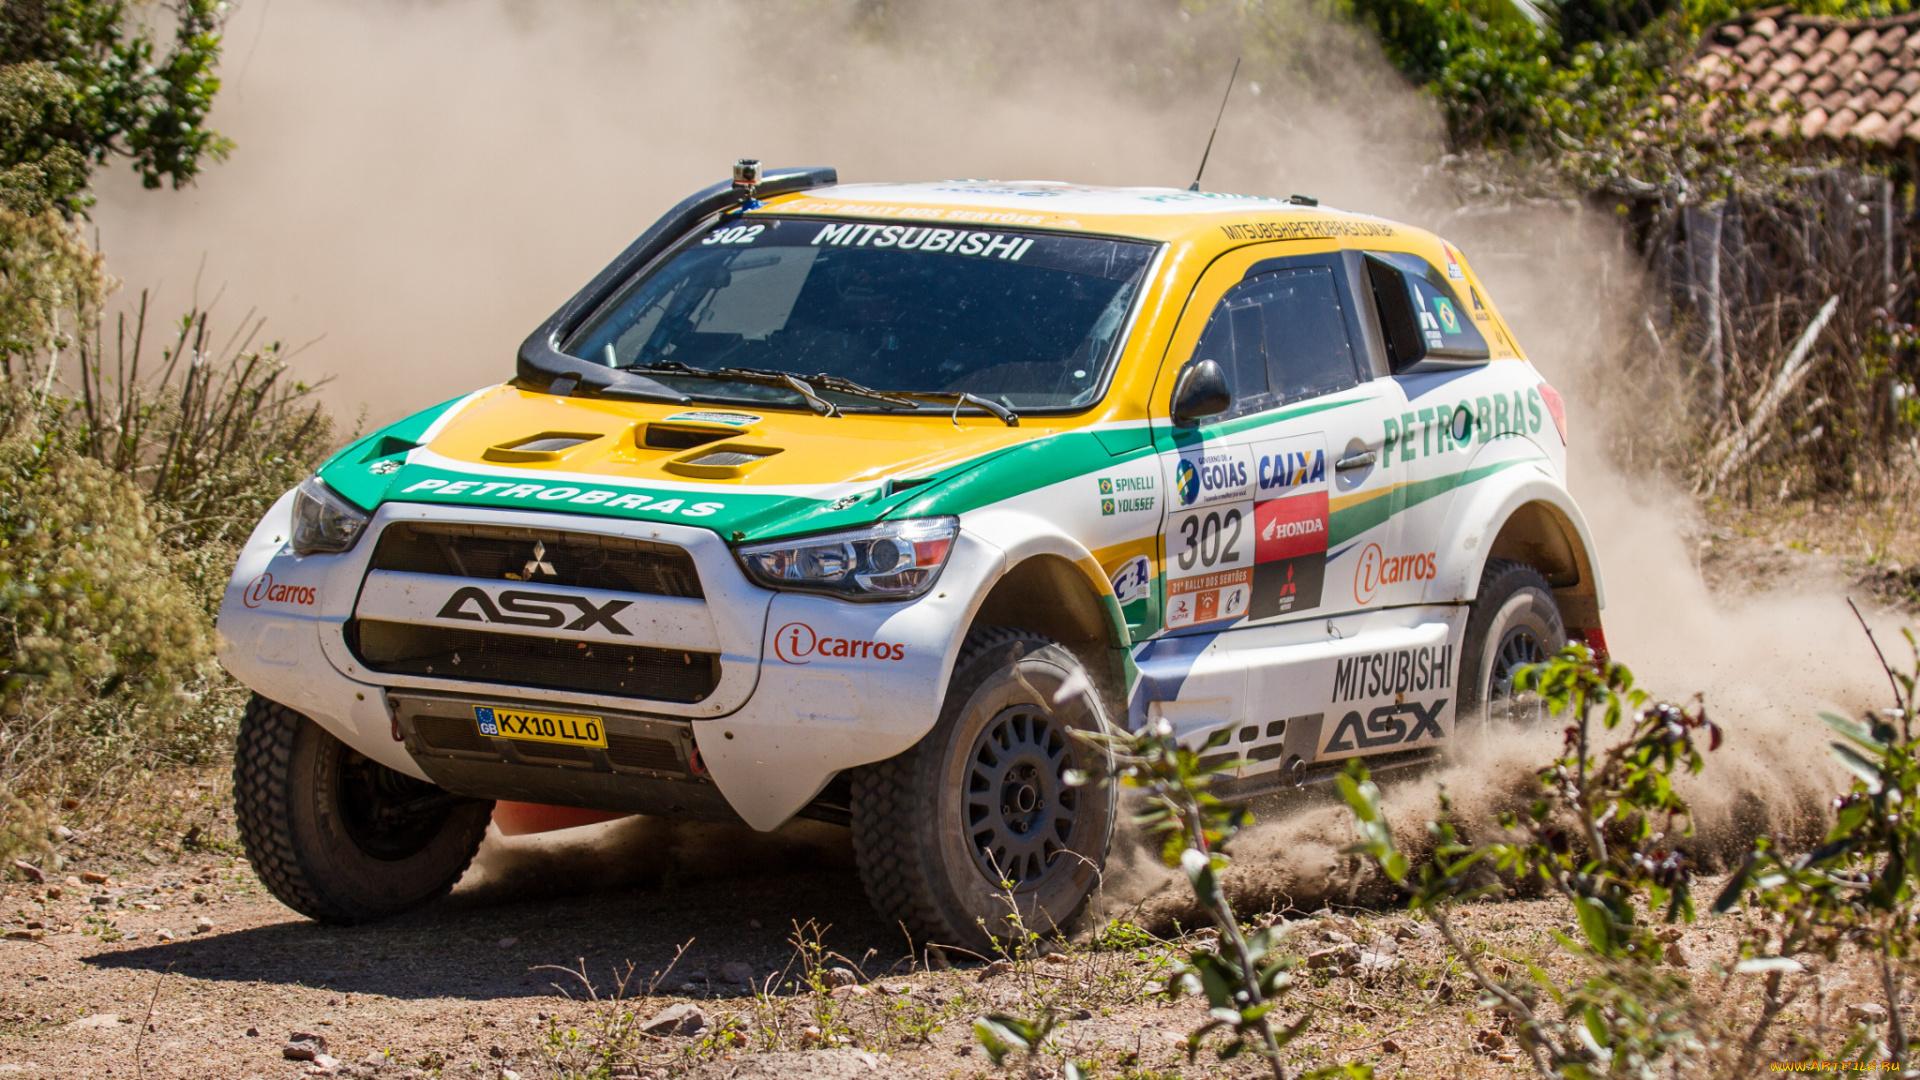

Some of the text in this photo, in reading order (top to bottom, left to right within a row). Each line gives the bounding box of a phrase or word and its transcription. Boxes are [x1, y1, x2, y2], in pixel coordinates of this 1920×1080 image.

[837, 204, 899, 215] RALLY
[898, 207, 944, 217] DOS
[702, 224, 766, 246] 302
[811, 223, 1035, 262] MITSUBISHI
[1219, 221, 1398, 240] MITSUBISHIPETROBRAS.COM.BR
[1383, 387, 1542, 468] PETROBRAS
[1116, 476, 1154, 492] SPINELLI
[1202, 456, 1247, 491] GOIÁS
[1258, 449, 1325, 490] CAIXA
[401, 479, 725, 516] PETROBRAS
[1118, 497, 1155, 513] YOUSSEF
[1178, 508, 1242, 571] 302
[1276, 518, 1324, 539] HONDA
[1185, 577, 1204, 590] RALLY
[1206, 575, 1218, 587] DOS
[1219, 570, 1247, 585] SERTÕES
[435, 586, 634, 636] ASX
[1332, 644, 1453, 703] MITSUBISHI
[480, 723, 498, 735] GB
[498, 714, 556, 737] KX10
[1323, 698, 1449, 753] ASX
